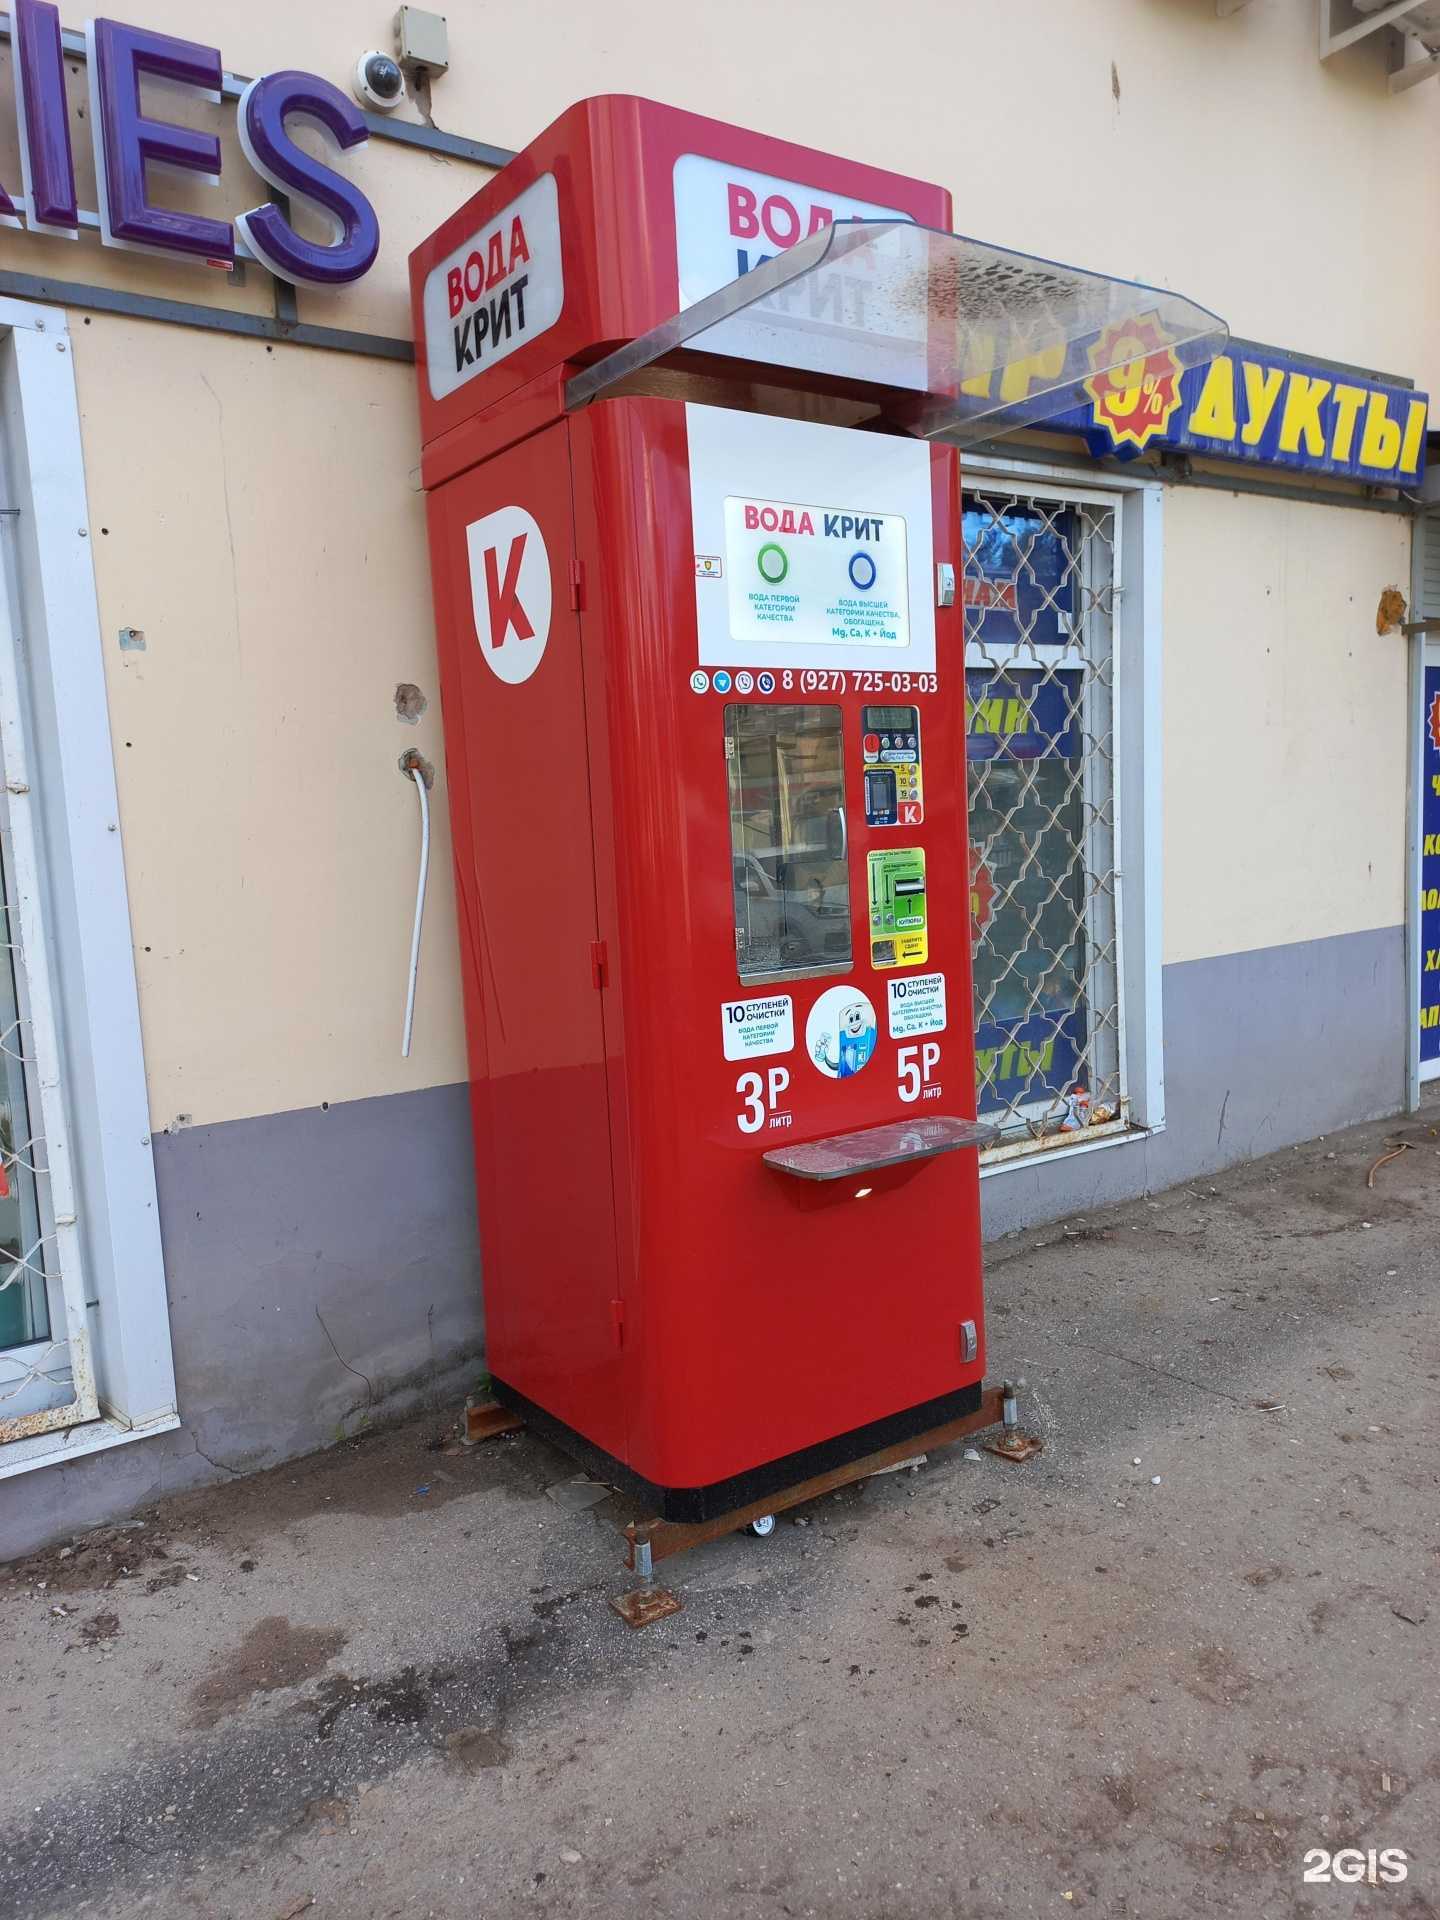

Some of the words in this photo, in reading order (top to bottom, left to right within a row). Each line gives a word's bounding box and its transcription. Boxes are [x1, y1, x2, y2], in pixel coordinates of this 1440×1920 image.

[0, 0, 380, 285] IES
[447, 216, 530, 319] ВОДА
[453, 275, 529, 374] КРИТ
[1188, 355, 1428, 474] ДУКТЫ
[744, 505, 815, 536] ВОДА
[824, 514, 884, 542] КРИТ
[748, 592, 769, 602] ВОДА
[770, 593, 800, 603] ПЕРВОЙ
[838, 599, 858, 607] ВОДА
[858, 599, 888, 608] ВЫСШЕЙ
[754, 603, 796, 612] КАТЕГОРИИ
[826, 608, 865, 617] КАТЕГОРИИ
[757, 612, 794, 622] КАЧЕСТВА
[832, 628, 848, 639] Mg,
[879, 628, 897, 640] Йод
[782, 669, 794, 690] 8
[800, 670, 846, 694] (927)
[853, 672, 938, 693] 725-03-03
[891, 982, 907, 999] 10
[907, 975, 942, 988] СТУПЕНЕЙ
[907, 985, 939, 997] ОЧИСТКИ
[726, 1005, 745, 1024] 10
[746, 998, 789, 1012] СТУПЕНЕЙ
[746, 1009, 785, 1021] ОЧИСТКИ
